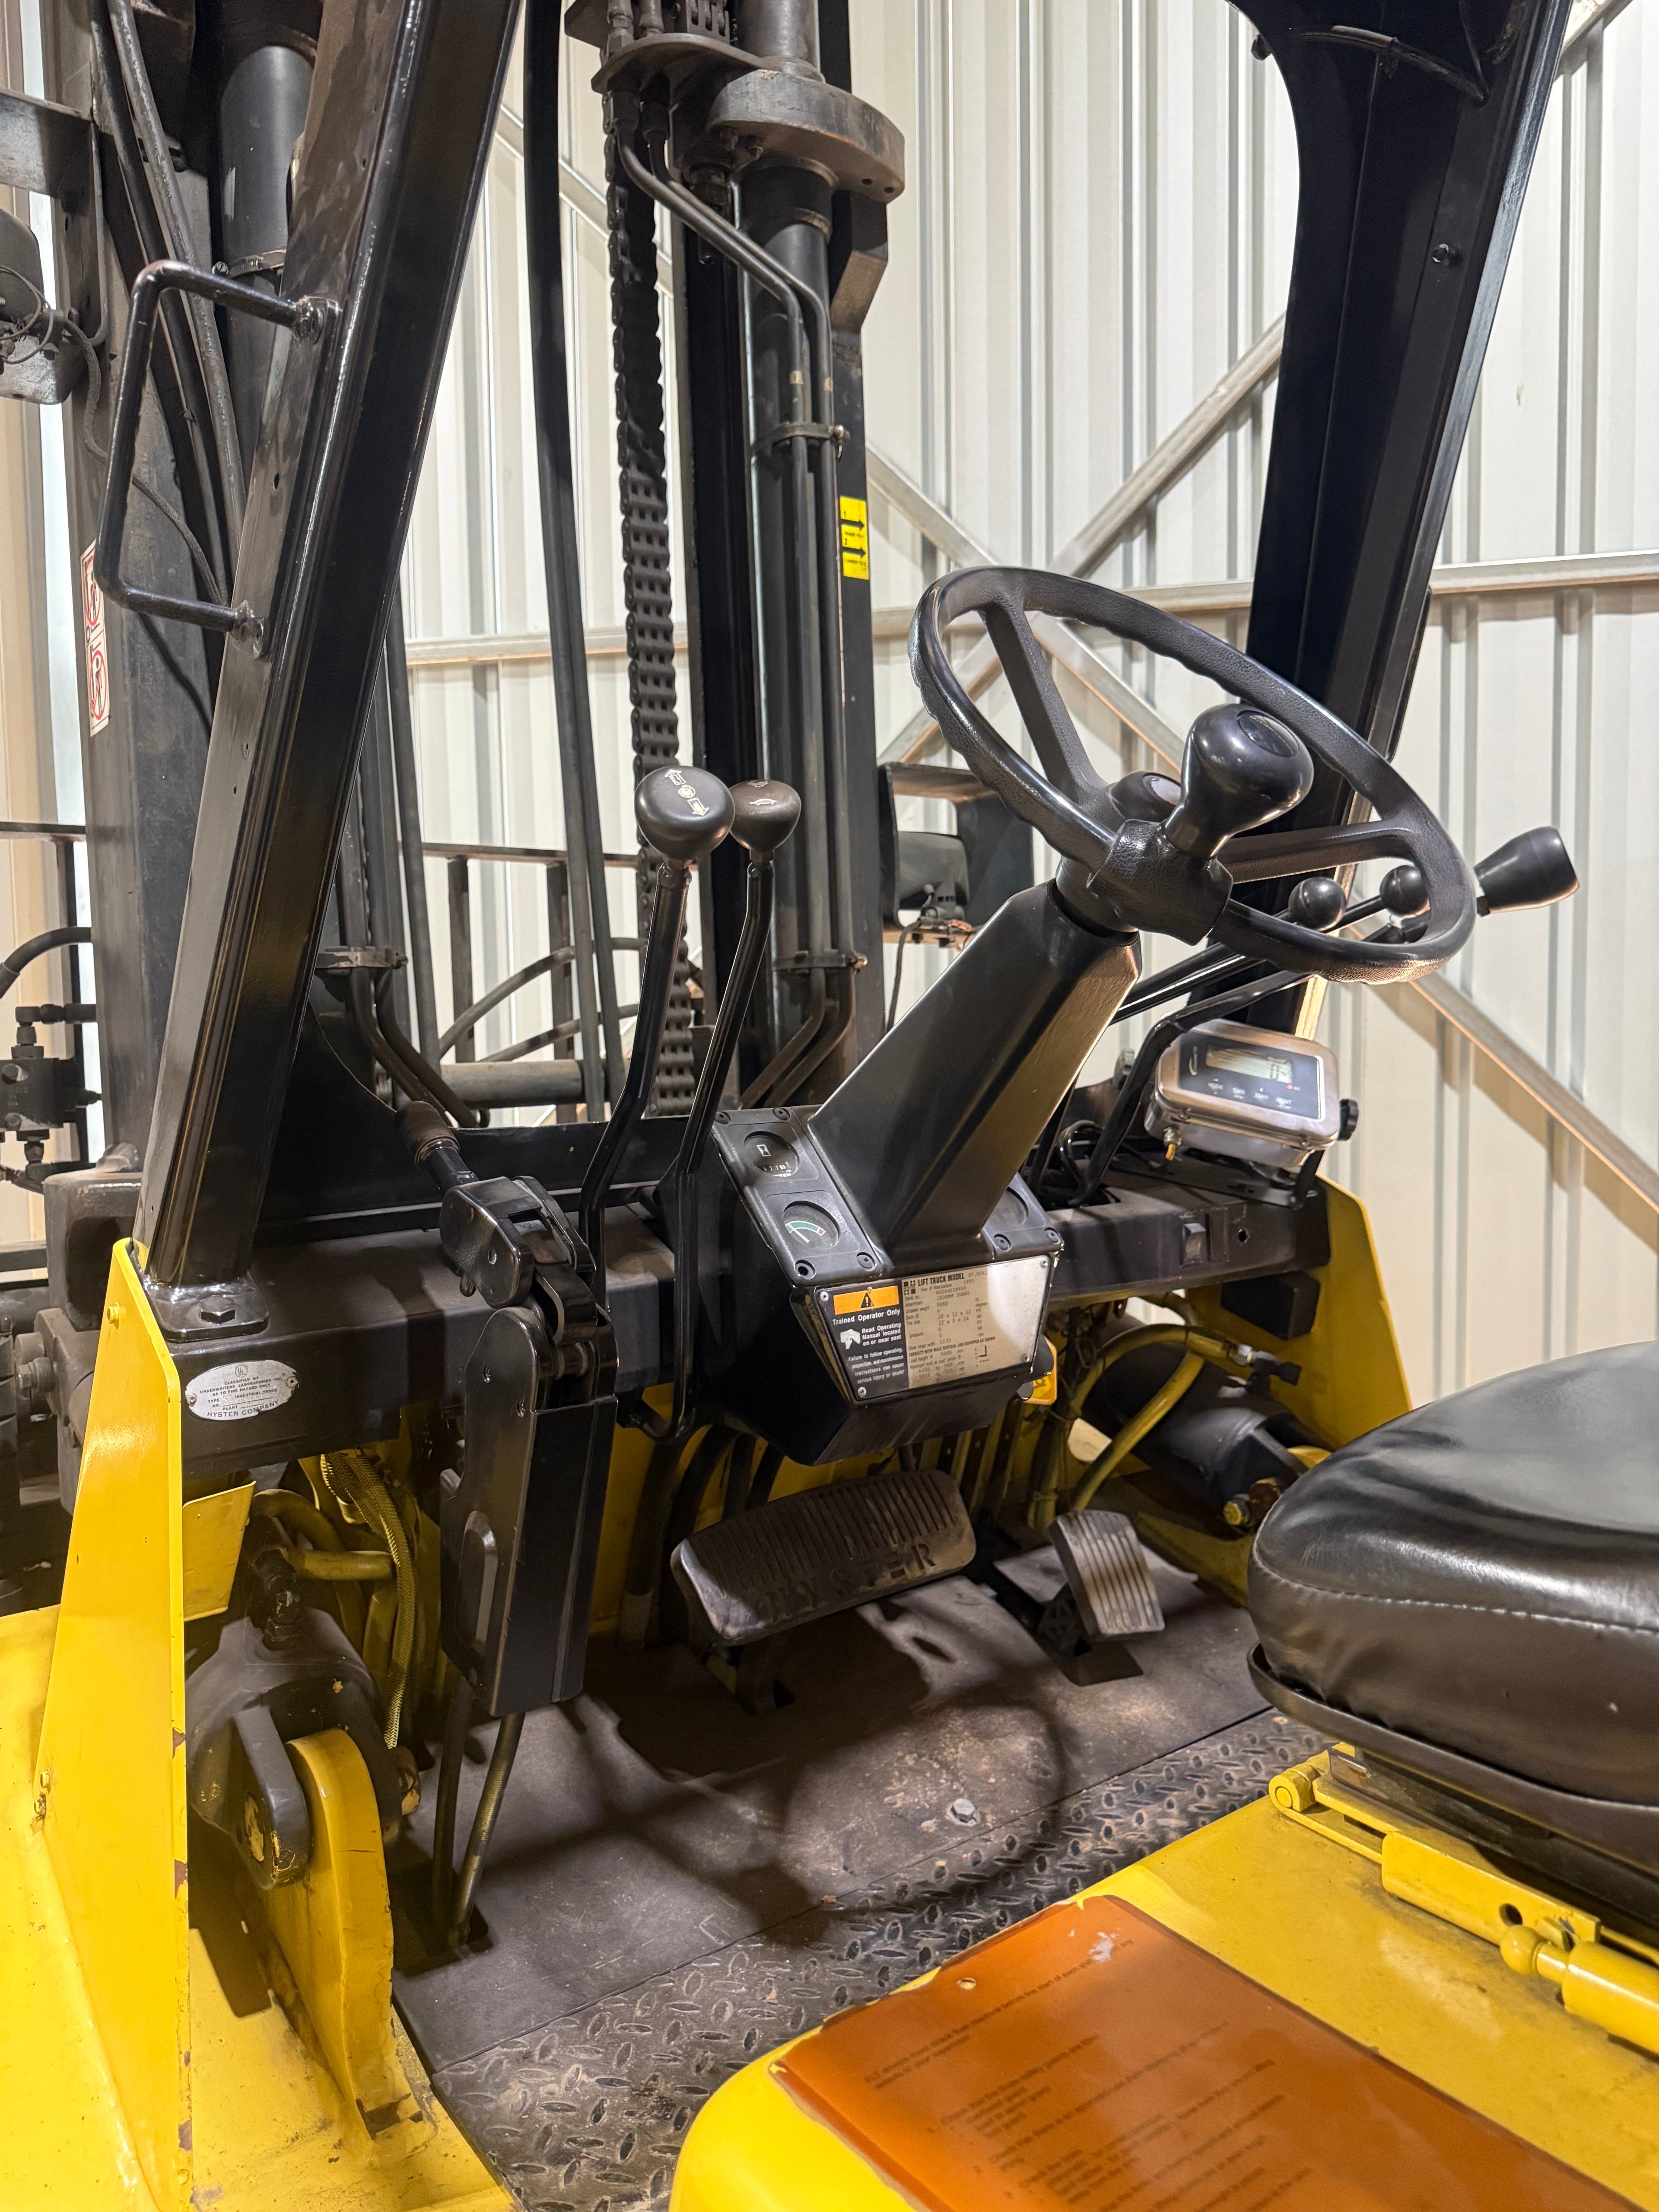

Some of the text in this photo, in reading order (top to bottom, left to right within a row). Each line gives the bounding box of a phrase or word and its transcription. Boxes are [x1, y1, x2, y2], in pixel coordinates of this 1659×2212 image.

[918, 1278, 928, 1286] LIFT
[929, 1275, 946, 1284] TRUCK
[947, 1273, 965, 1281] MODEL
[832, 1316, 855, 1325] Trained
[858, 1311, 884, 1322] Operator
[877, 1322, 901, 1332] Operating
[880, 1355, 903, 1363] maintenance
[855, 1367, 881, 1376] instructions
[200, 1385, 235, 1394] UNDERWRITERS
[238, 1379, 271, 1387] LABORATORIES
[242, 1399, 279, 1415] COMPANY
